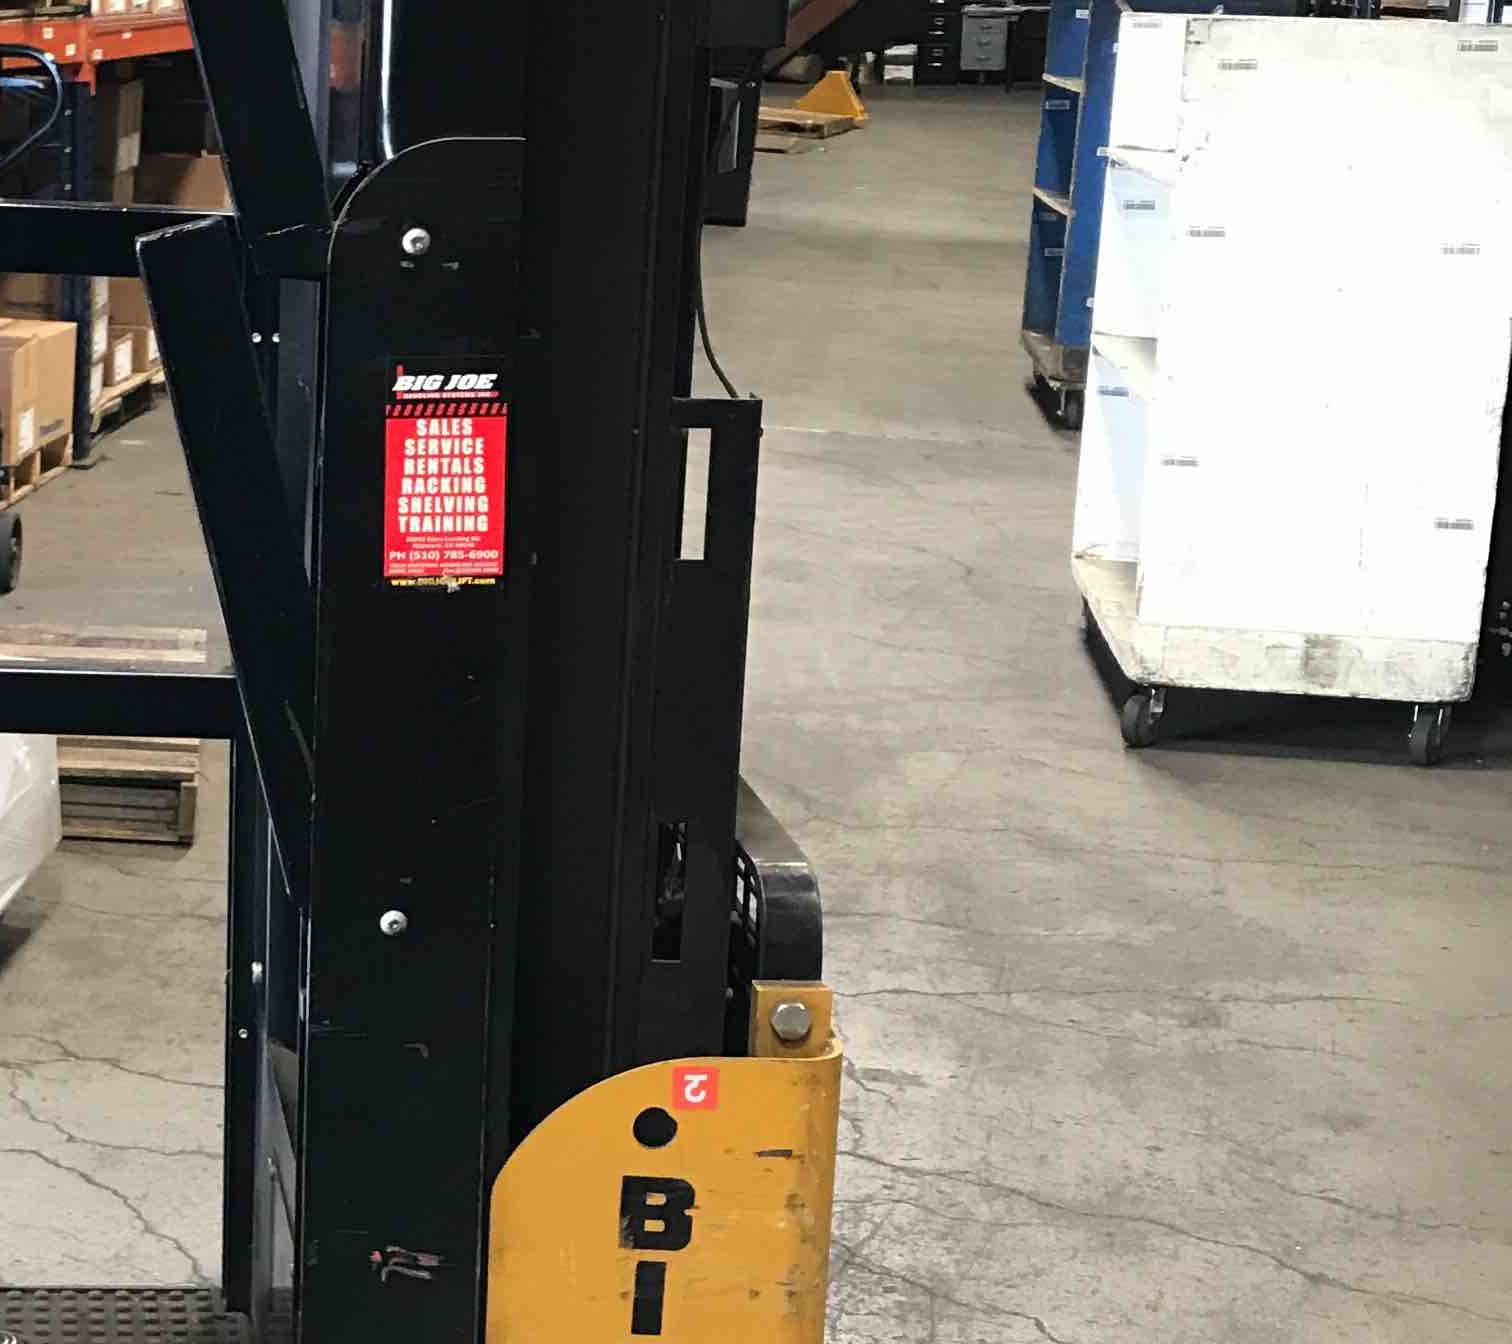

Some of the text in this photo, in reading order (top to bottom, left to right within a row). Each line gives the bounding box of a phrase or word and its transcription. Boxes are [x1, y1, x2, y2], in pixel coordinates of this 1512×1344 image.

[391, 373, 499, 392] BIG JOE
[415, 418, 473, 436] SALES
[404, 437, 486, 457] SERVICE
[403, 456, 486, 476] RENTALS
[400, 476, 488, 495] RACKING
[397, 495, 490, 515] SHELVING
[397, 514, 490, 534] TRAINING
